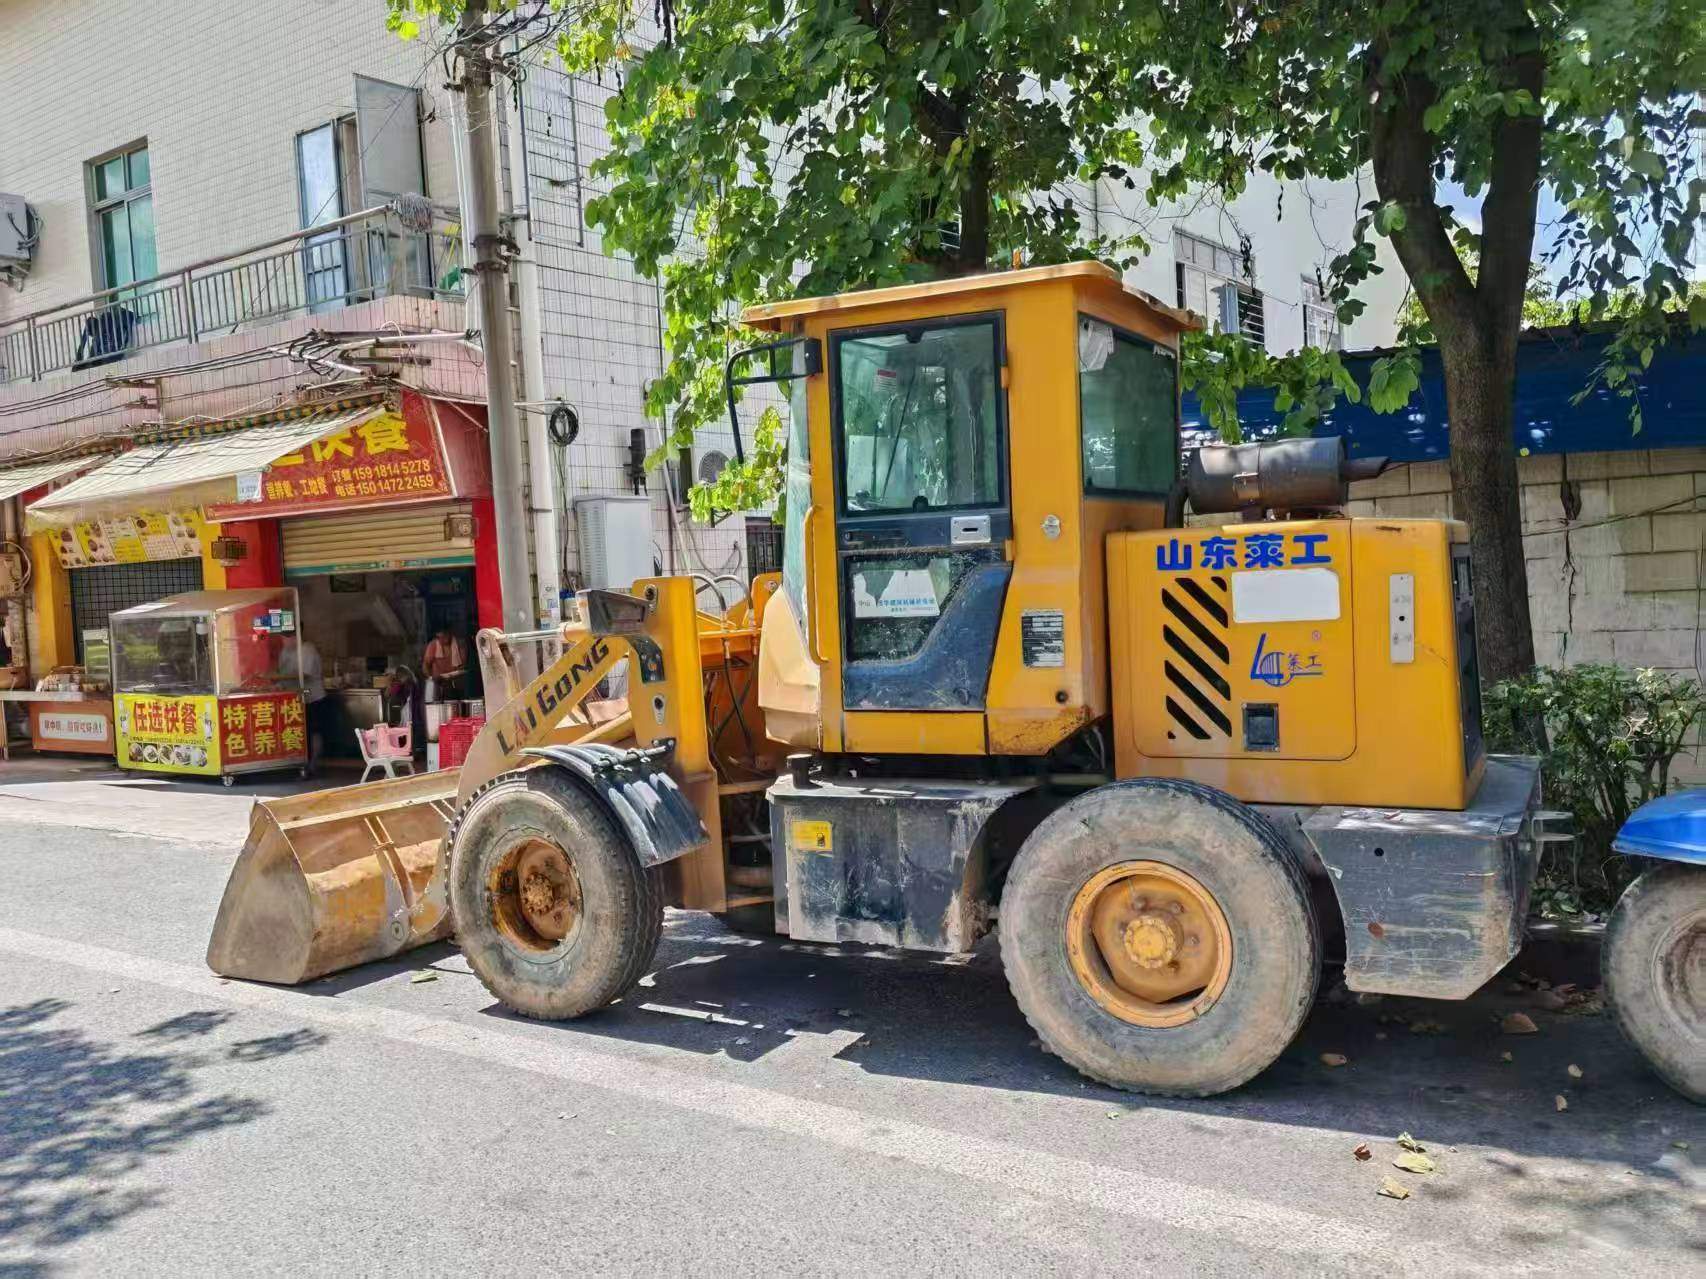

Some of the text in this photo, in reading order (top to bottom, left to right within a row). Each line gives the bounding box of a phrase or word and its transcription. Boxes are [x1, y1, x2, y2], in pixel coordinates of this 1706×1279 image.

[353, 466, 373, 481] 159
[374, 463, 400, 478] 1814
[400, 459, 431, 475] 5278
[357, 479, 377, 496] 150
[377, 477, 405, 493] 1472
[404, 473, 434, 490] 2459
[1157, 533, 1332, 571] 山东莱工
[133, 699, 198, 735] 任选快餐
